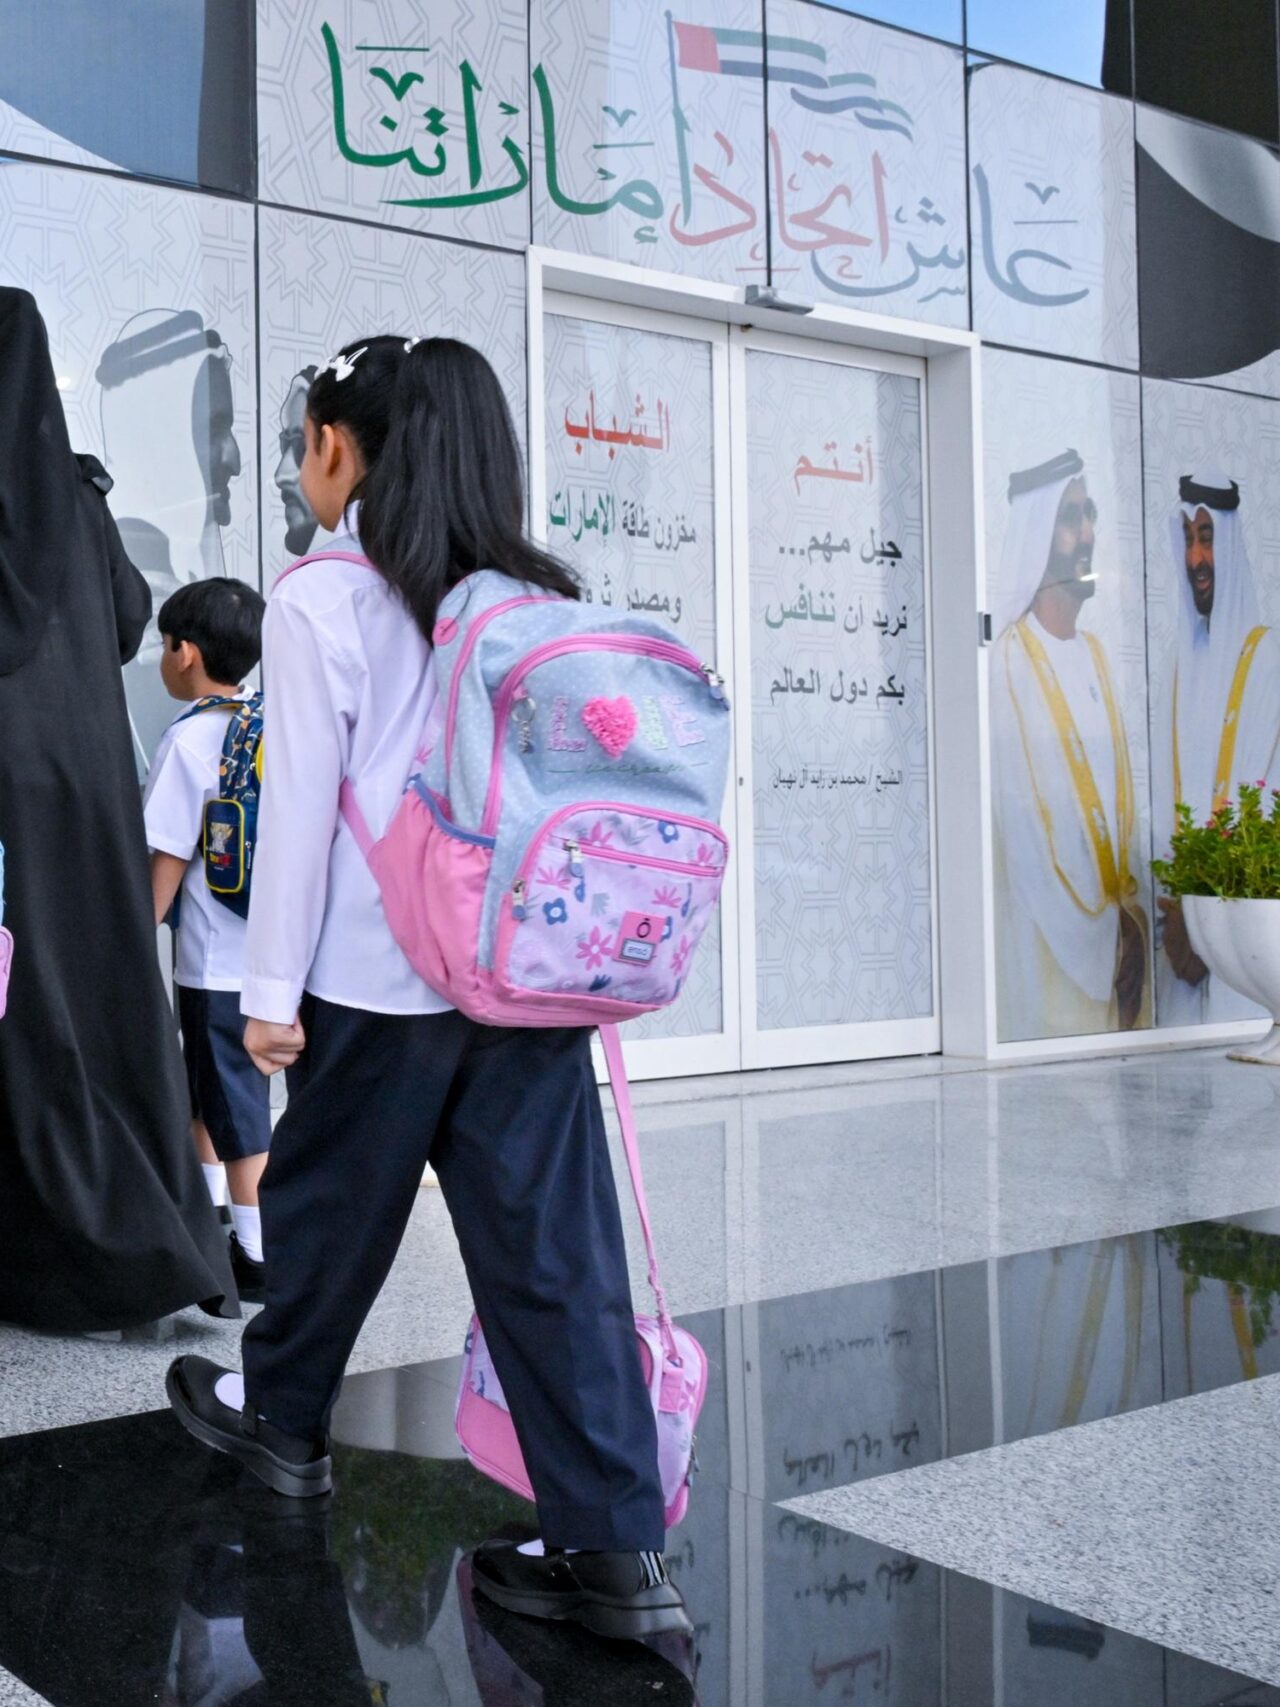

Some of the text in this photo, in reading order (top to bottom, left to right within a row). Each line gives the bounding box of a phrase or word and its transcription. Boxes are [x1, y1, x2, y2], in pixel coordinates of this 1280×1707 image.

[811, 162, 1089, 307] عاش
[564, 388, 670, 461] الشباب
[794, 435, 873, 497] أنتم
[622, 500, 650, 538] طاقة
[654, 513, 696, 550] مخزون
[860, 527, 902, 567] جيل
[626, 587, 682, 623] ومصدر
[873, 605, 908, 636] نريد
[770, 666, 906, 710] بكم دول العالم
